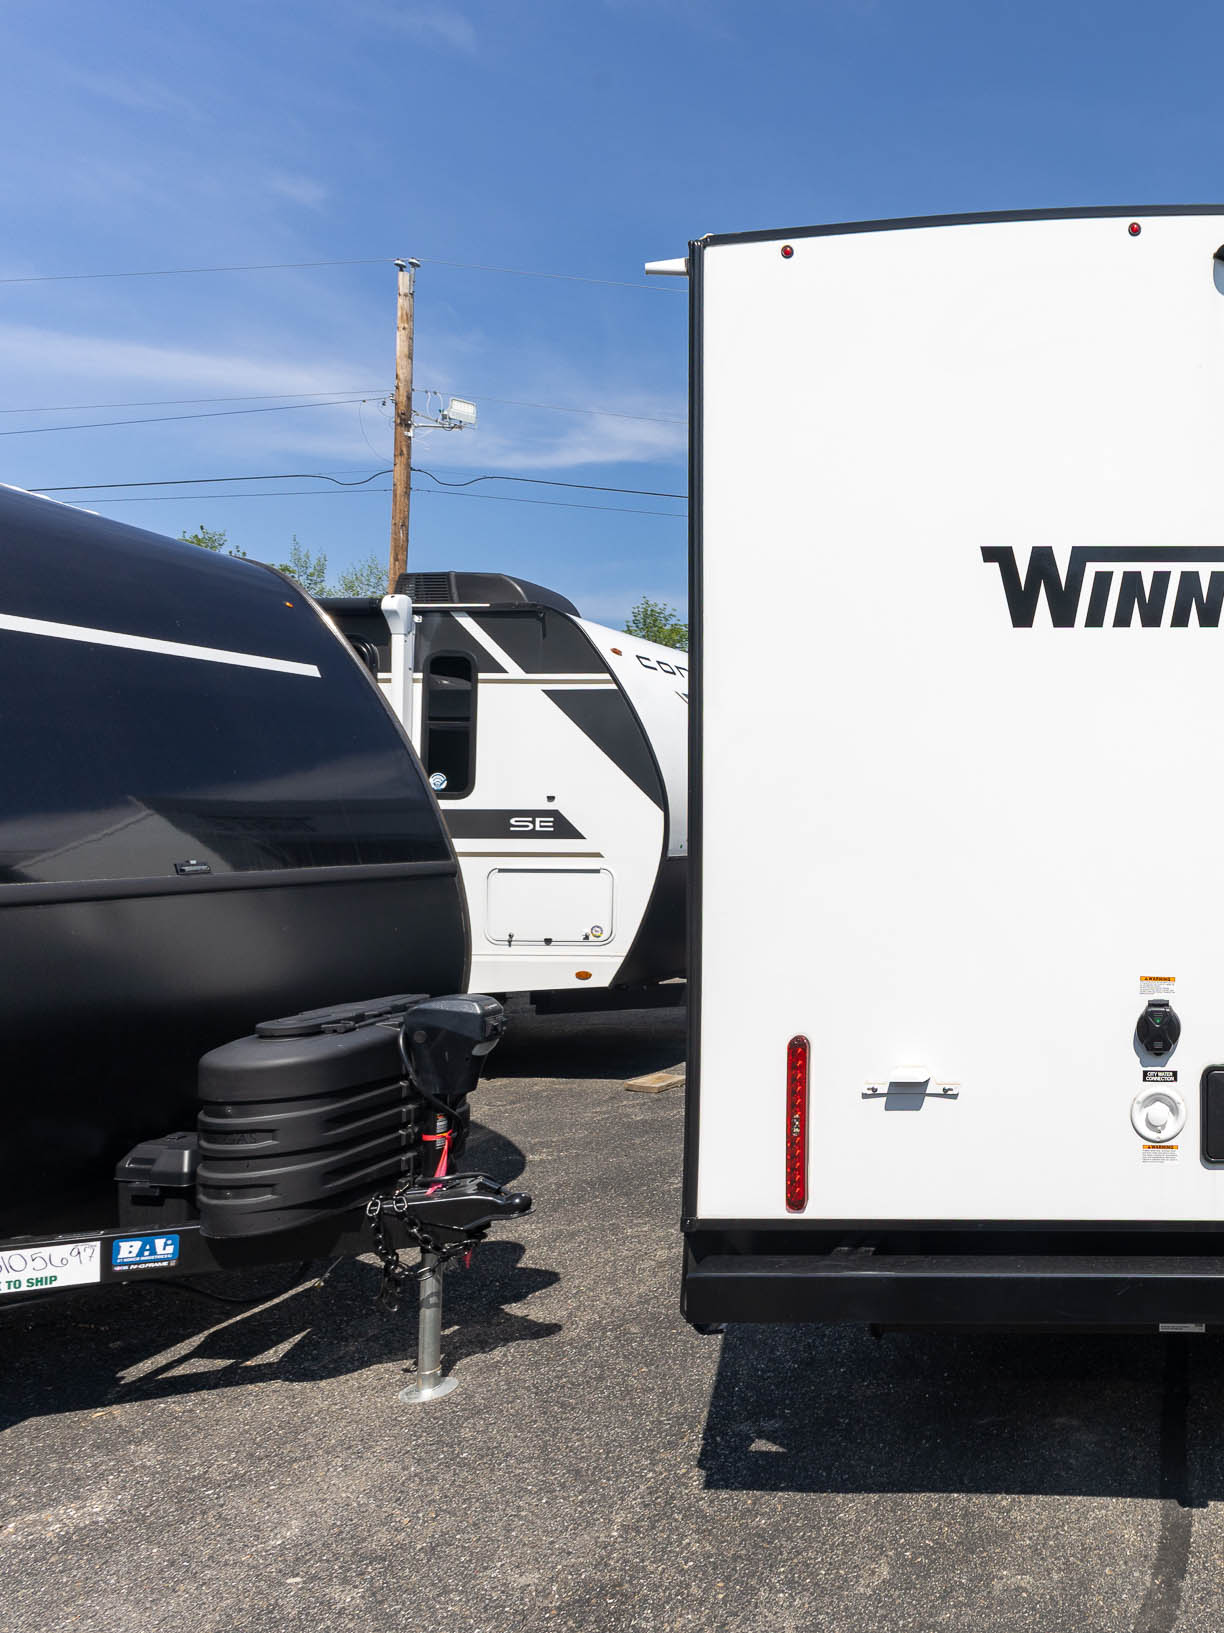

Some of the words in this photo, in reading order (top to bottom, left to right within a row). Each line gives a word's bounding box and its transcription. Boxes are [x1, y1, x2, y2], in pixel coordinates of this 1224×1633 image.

[509, 817, 554, 831] SE
[6, 1280, 21, 1290] TO
[26, 1275, 57, 1288] SHIP
